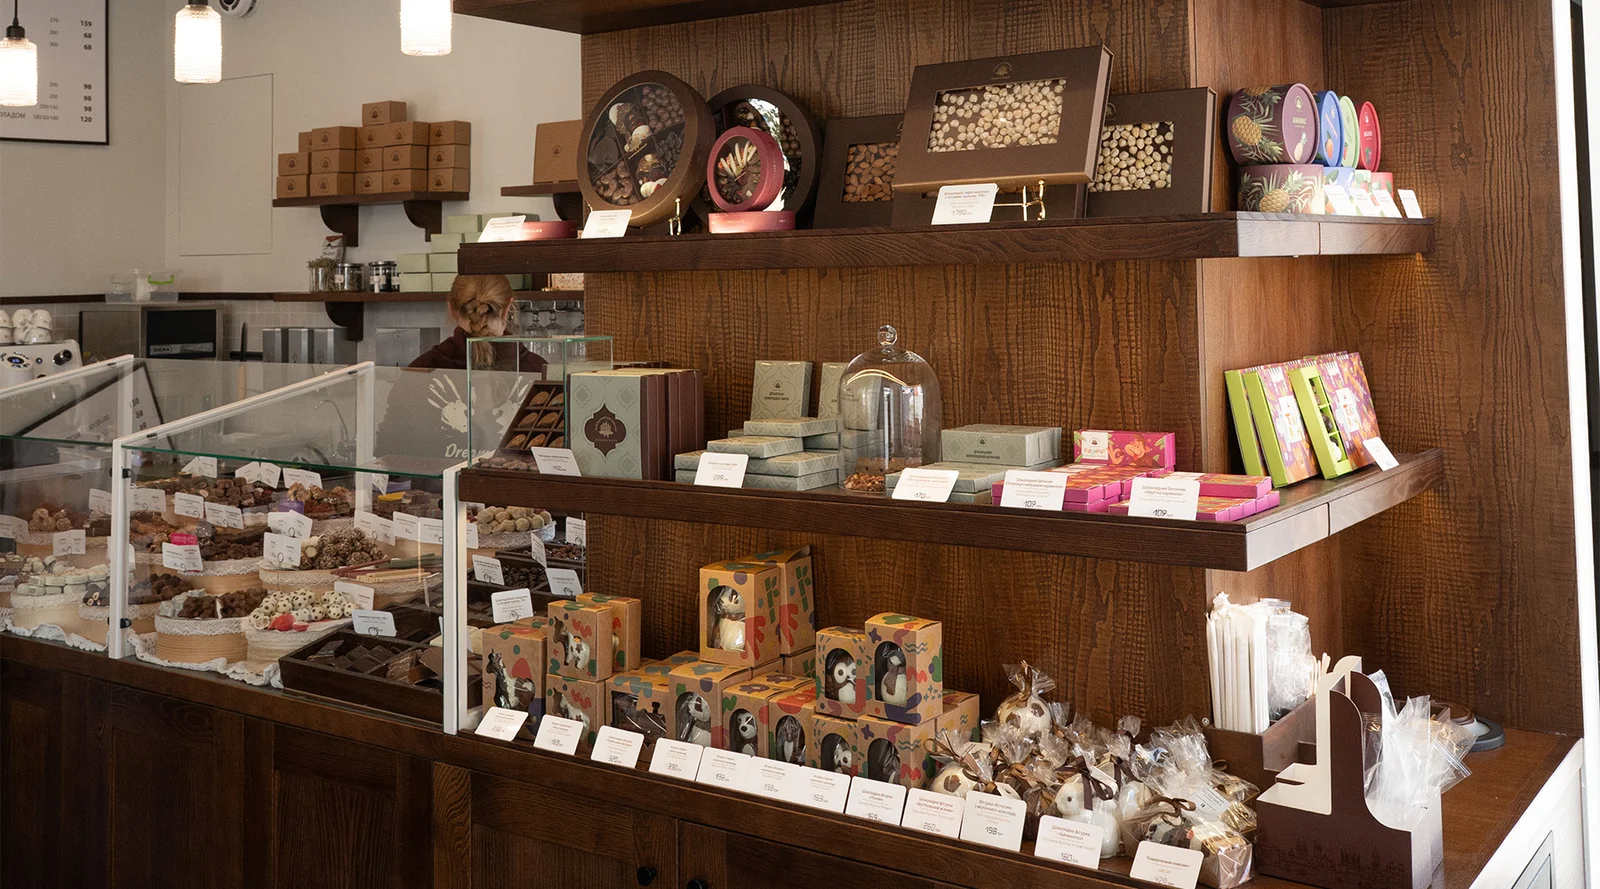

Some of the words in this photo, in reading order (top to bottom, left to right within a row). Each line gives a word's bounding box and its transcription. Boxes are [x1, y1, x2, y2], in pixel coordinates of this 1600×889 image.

[1023, 500, 1037, 508] 109
[1152, 509, 1168, 517] 109
[985, 826, 998, 836] 198
